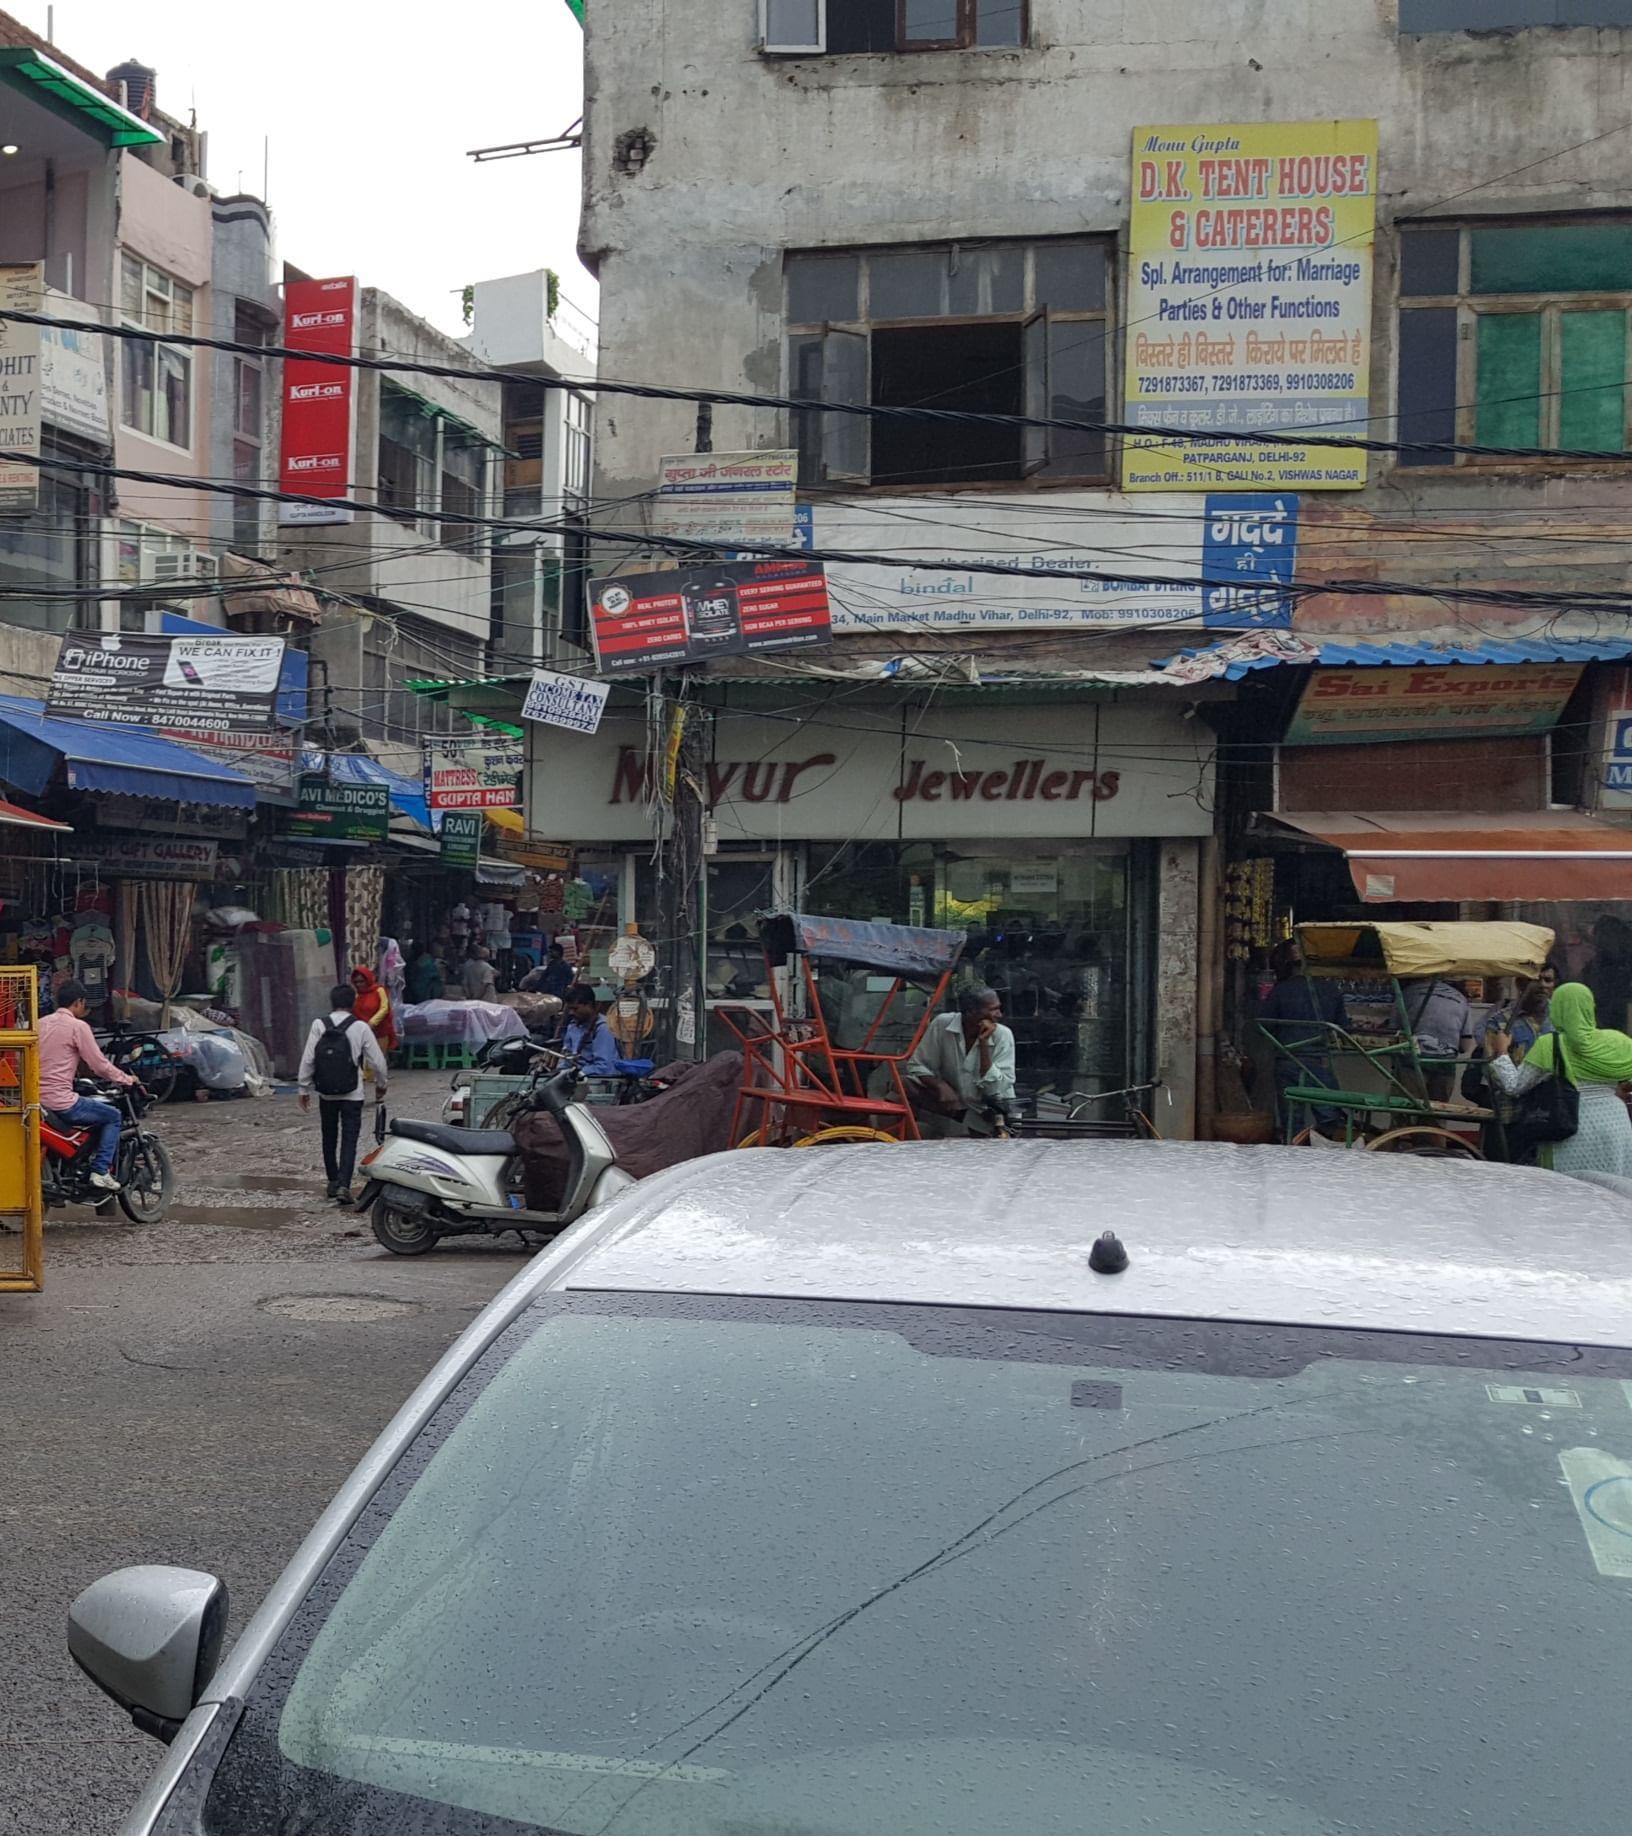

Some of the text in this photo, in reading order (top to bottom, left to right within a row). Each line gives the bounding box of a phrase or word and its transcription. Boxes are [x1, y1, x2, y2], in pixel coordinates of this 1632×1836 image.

[1190, 134, 1241, 154] Gupta
[1140, 155, 1366, 199] D.K. TENT HOUSE
[1170, 206, 1332, 249] & CATERERS
[1141, 257, 1361, 290] Spl. Arrangement for: Marriage
[1160, 295, 1340, 321] Parties & Other Functions
[292, 312, 345, 328] Kurl-on
[290, 384, 343, 399] Kurl-on
[1138, 373, 1354, 395] 7291873367, 7291873369, 9910308206
[287, 456, 341, 471] Kurl-on
[1183, 451, 1306, 465] PATPARGANJ, DELHI-92
[1129, 472, 1161, 483] Branch
[1226, 470, 1248, 481] GALI
[1278, 469, 1323, 481] VISHWAS
[1325, 469, 1359, 480] NAGAR
[900, 576, 974, 594] bindal
[831, 608, 1196, 626] 34, Main Market Madhu Vihar, Delhi-92, Mob: 9910308206
[85, 651, 150, 670] iPhone
[179, 647, 273, 657] WE CAN FIX IT
[532, 681, 603, 706] INCOME TAX
[1313, 671, 1576, 697] Sai Exports
[529, 691, 600, 717] CONSULTANT
[83, 709, 108, 720] Call
[111, 711, 141, 723] Now
[152, 714, 230, 730] 8470044600
[434, 768, 477, 787] MATTRESS
[609, 744, 1121, 805] Myur Jewellers
[325, 789, 387, 806] MEDICO'S
[438, 791, 482, 806] GUPTA
[446, 818, 476, 835] RAVI
